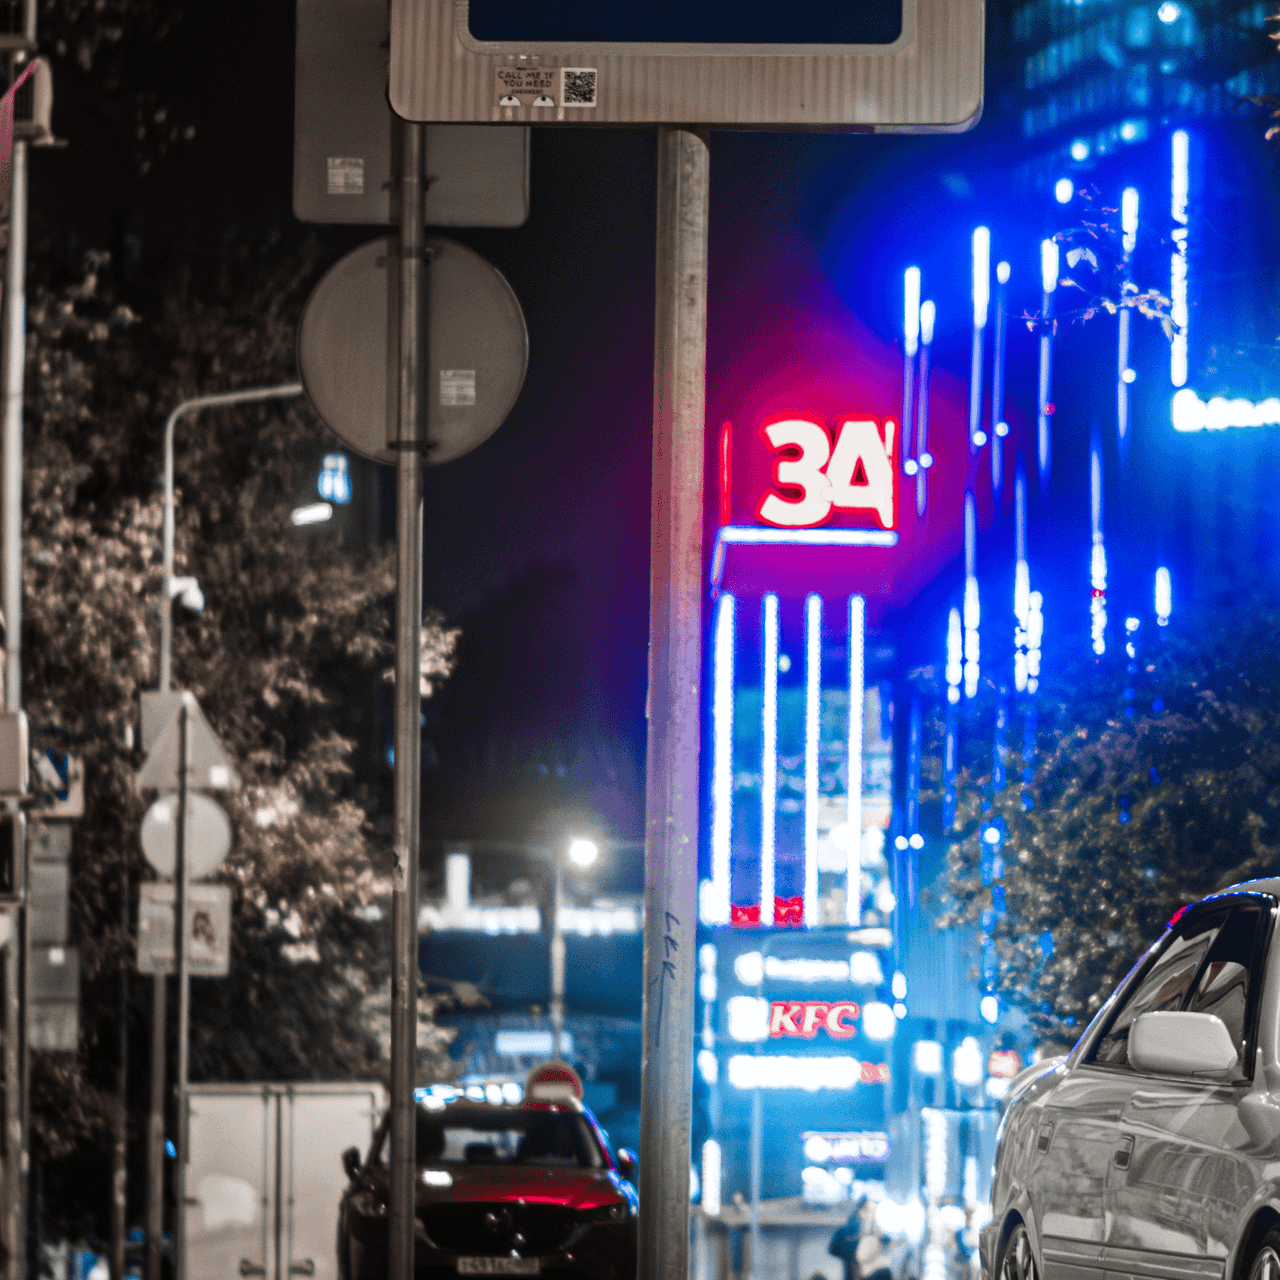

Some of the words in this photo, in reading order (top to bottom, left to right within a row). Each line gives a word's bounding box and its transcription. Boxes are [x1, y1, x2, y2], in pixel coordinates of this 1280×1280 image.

[497, 71, 522, 80] CALL
[526, 72, 541, 80] ME
[544, 72, 555, 80] IF
[503, 80, 523, 88] YOU
[525, 80, 552, 88] NEED
[769, 1001, 860, 1038] KFC
